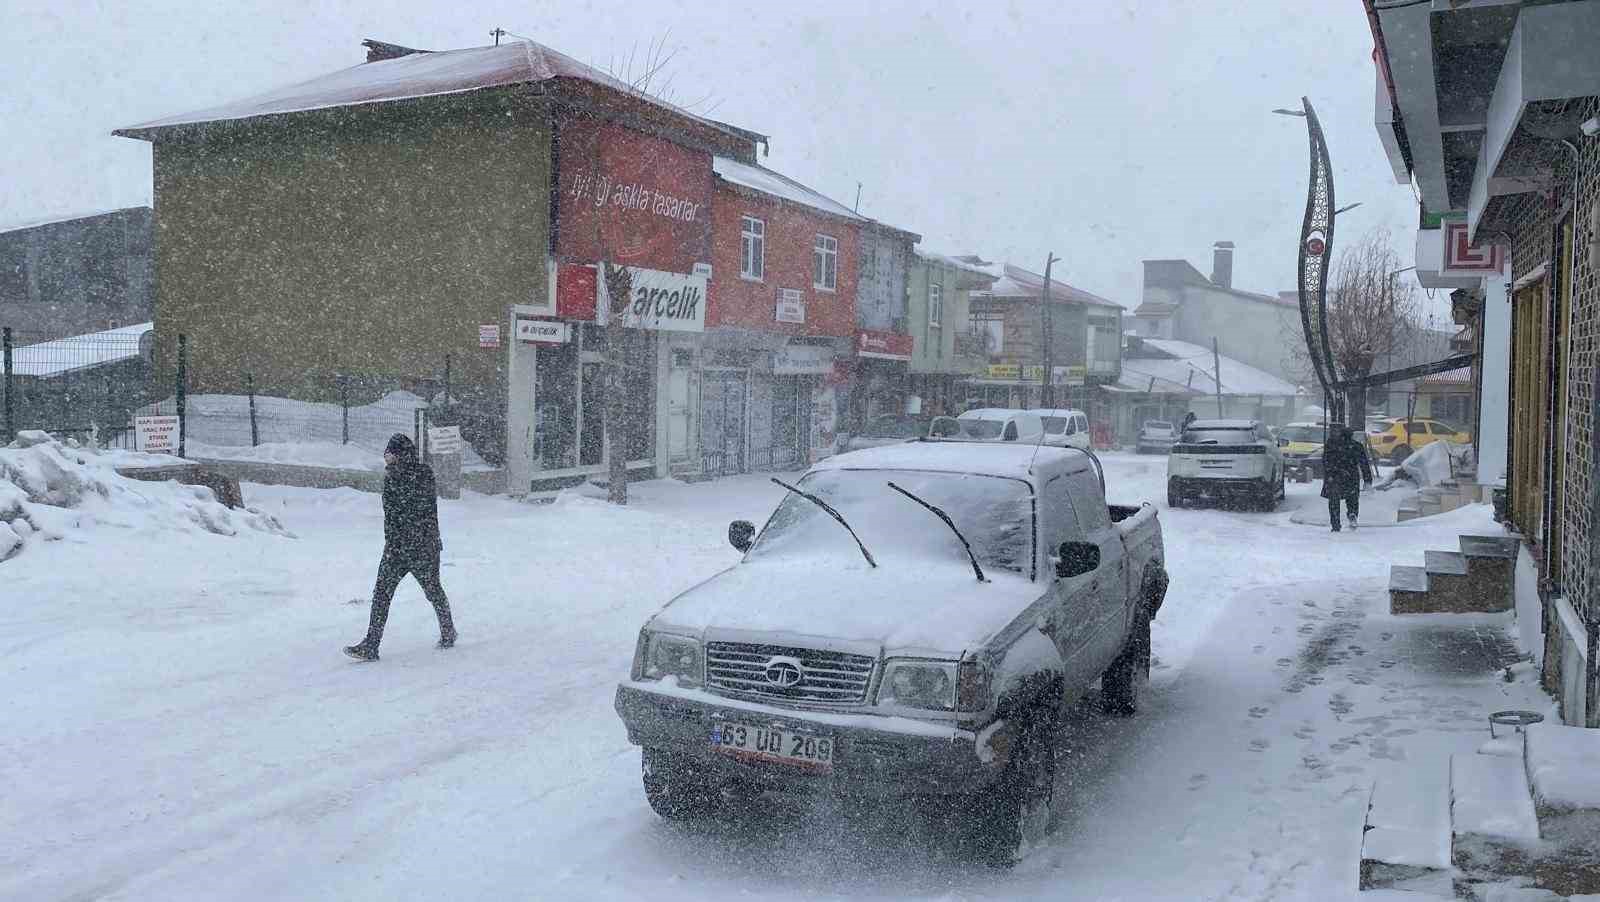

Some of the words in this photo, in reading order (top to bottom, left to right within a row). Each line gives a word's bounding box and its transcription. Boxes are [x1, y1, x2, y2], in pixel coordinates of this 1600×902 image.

[615, 184, 649, 212] aşkla
[652, 190, 698, 221] tasarlar
[633, 285, 701, 325] arçelik
[790, 735, 831, 761] 209
